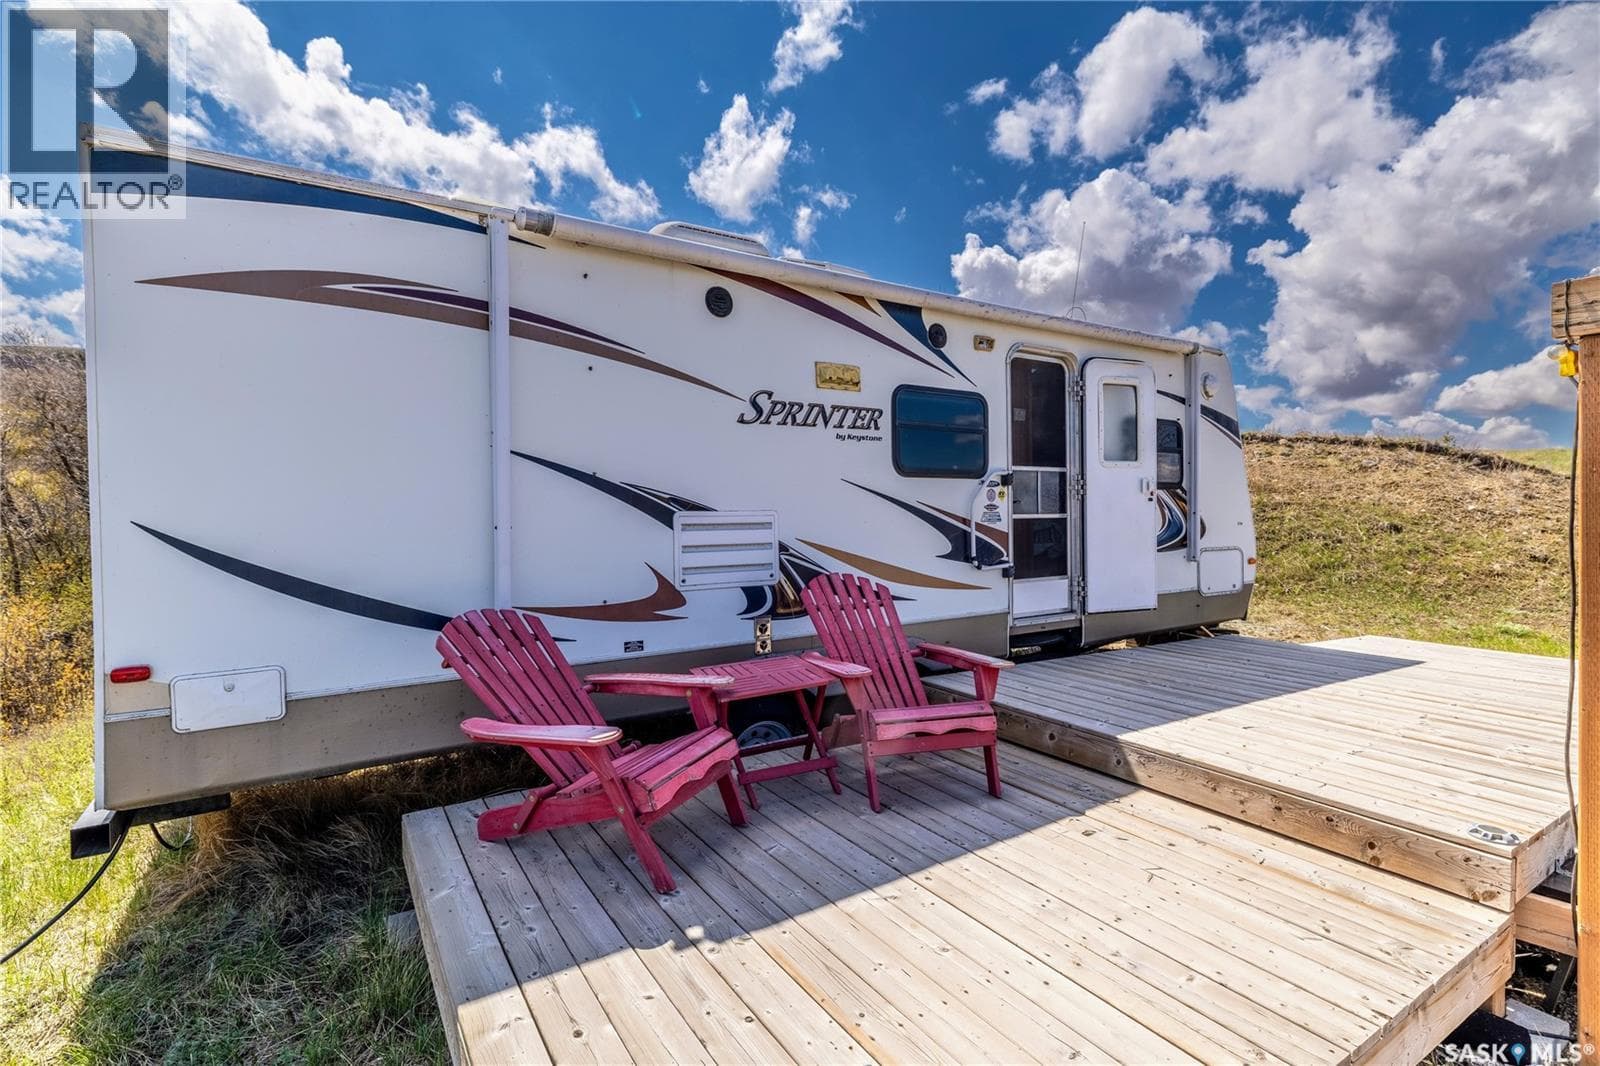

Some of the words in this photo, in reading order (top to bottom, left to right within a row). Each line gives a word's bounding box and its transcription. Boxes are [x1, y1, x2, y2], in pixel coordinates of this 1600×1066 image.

[736, 389, 884, 431] SPRINTER
[835, 432, 846, 442] by
[846, 433, 883, 442] Keystone
